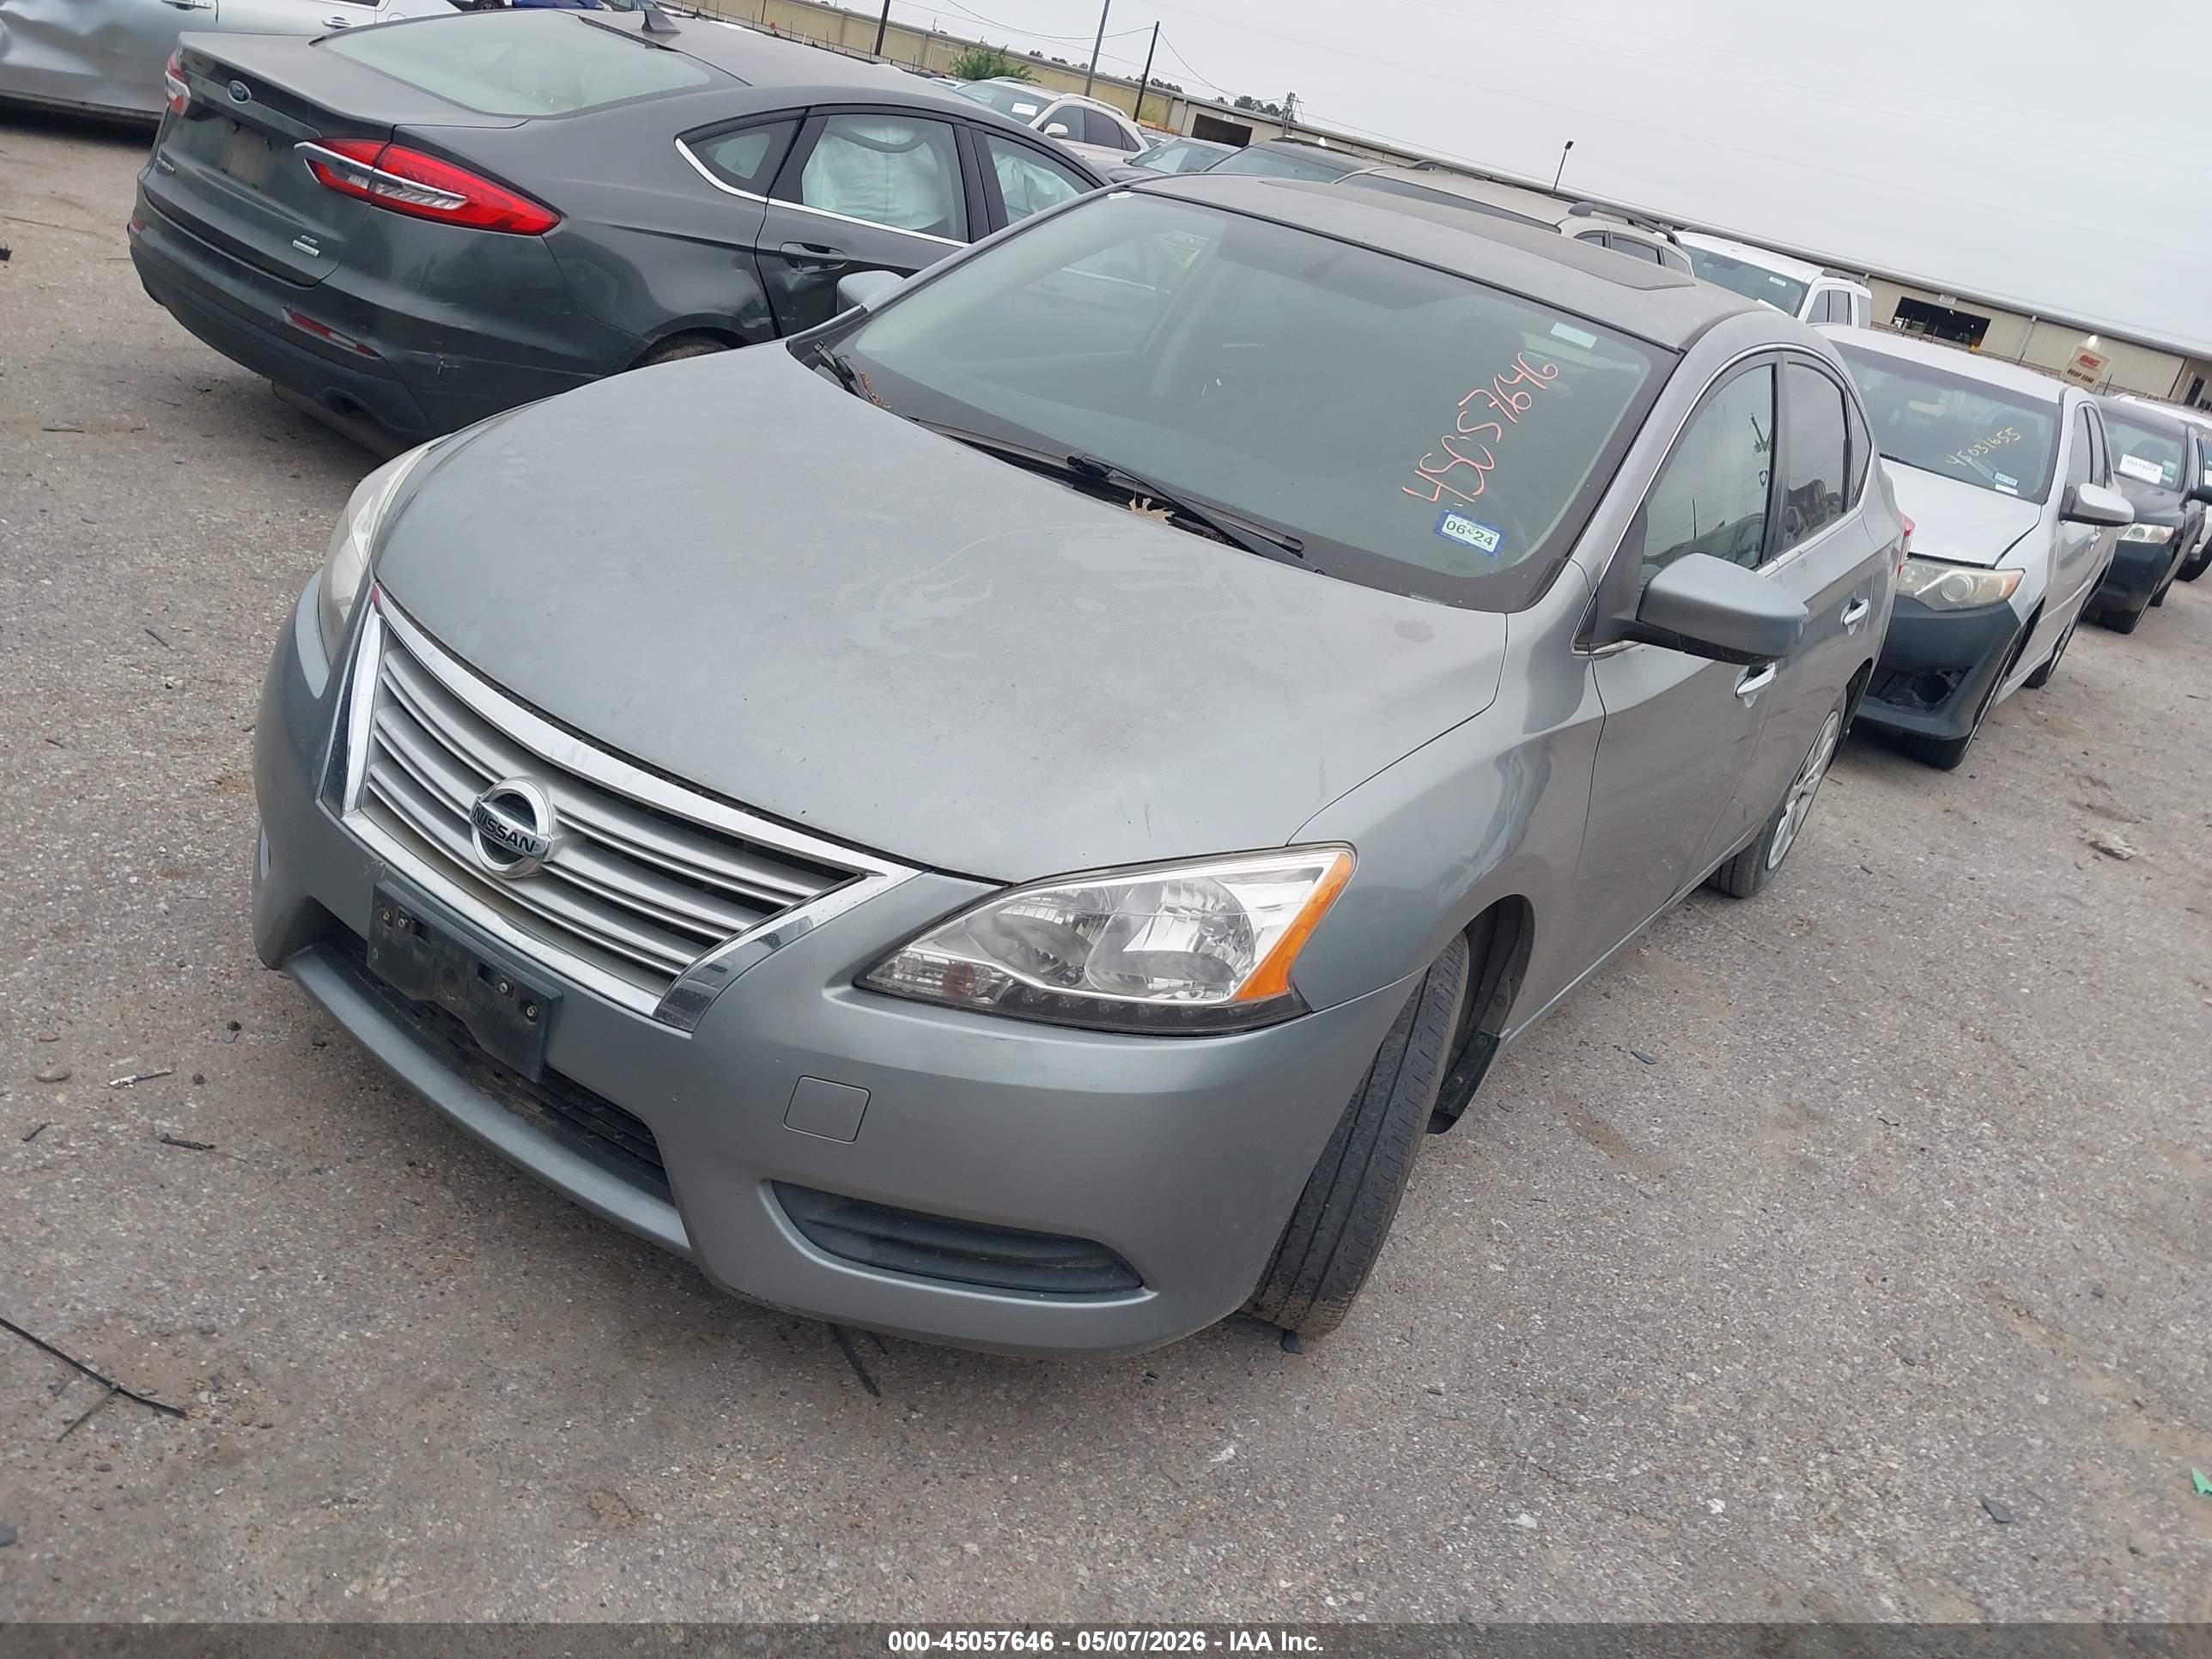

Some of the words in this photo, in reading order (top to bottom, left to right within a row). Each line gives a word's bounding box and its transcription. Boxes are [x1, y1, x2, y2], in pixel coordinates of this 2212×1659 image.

[1401, 351, 1559, 503] 45057646
[1945, 427, 2021, 466] 45031655
[1446, 520, 1467, 534] 06
[1474, 531, 1494, 546] 24
[473, 806, 536, 853] NISSAN
